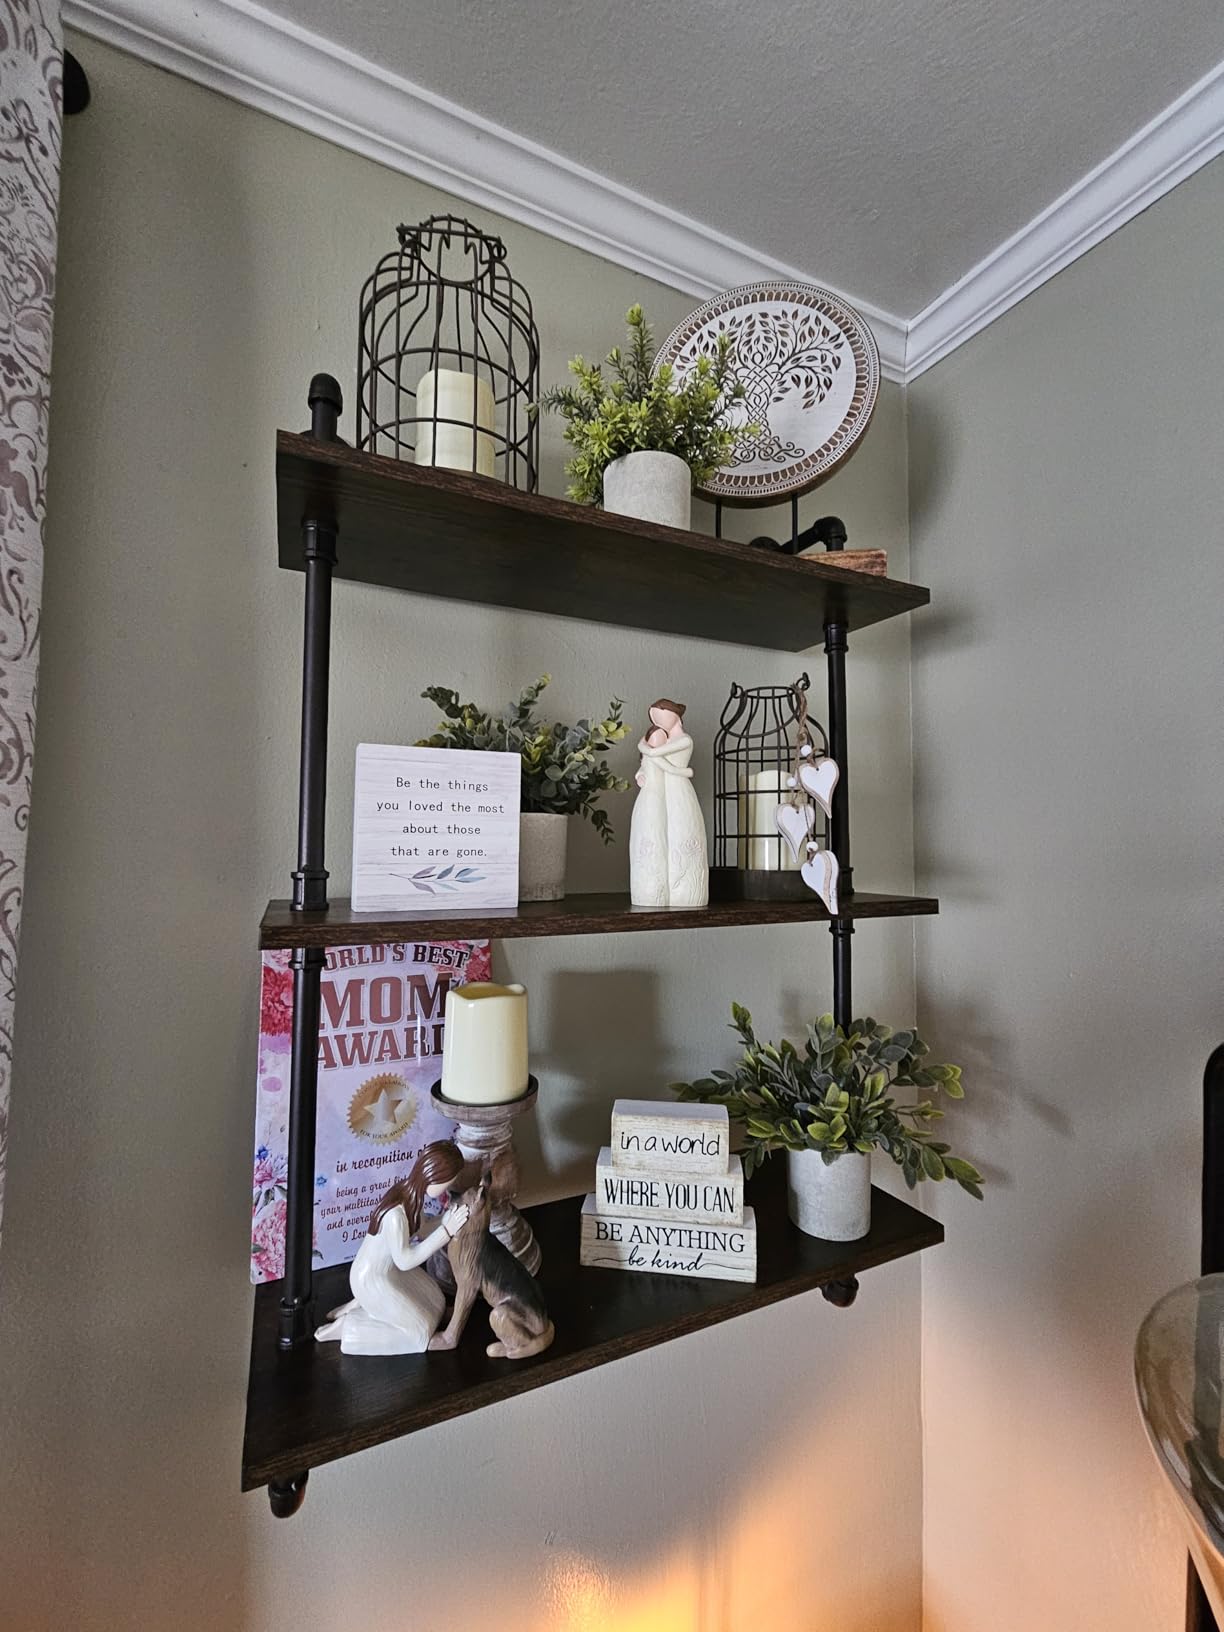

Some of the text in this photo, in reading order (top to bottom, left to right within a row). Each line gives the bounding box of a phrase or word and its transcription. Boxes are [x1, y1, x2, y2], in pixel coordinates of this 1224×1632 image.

[396, 777, 489, 793] Be the things
[376, 800, 505, 814] you loved the most
[402, 823, 481, 835] about those
[391, 846, 487, 858] that are gone.
[323, 944, 469, 971] ORLD'S BEST
[620, 1131, 720, 1156] in a world
[336, 1160, 348, 1173] in
[352, 1149, 414, 1170] recognition
[336, 1187, 358, 1198] being
[369, 1180, 391, 1193] great
[604, 1178, 734, 1213] WHERE YOU CAN
[320, 1207, 342, 1219] your
[326, 1219, 344, 1231] and
[351, 1229, 367, 1241] Lov
[595, 1221, 745, 1253] BE ANYTHING
[627, 1245, 703, 1272] be kind
